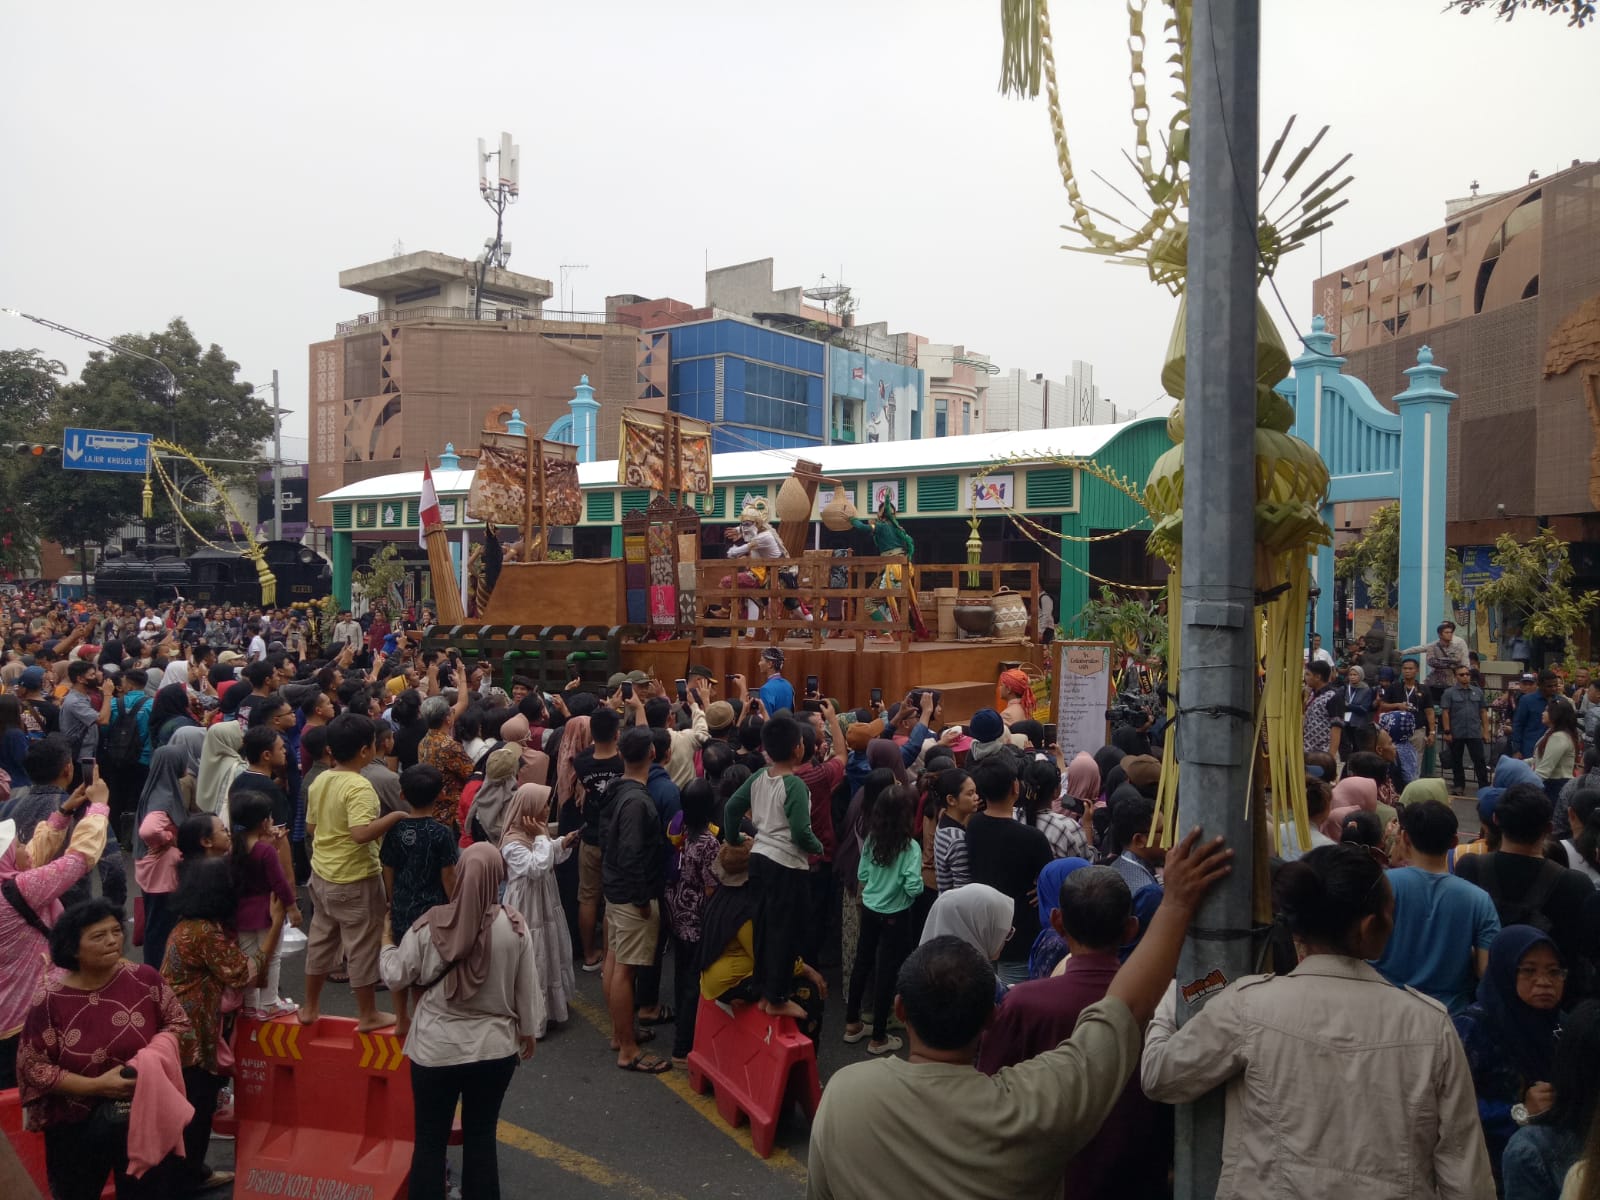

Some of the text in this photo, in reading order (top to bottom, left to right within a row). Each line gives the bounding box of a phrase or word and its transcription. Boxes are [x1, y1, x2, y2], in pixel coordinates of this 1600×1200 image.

[84, 455, 105, 464] LAJUR
[107, 456, 132, 465] KHUSUS
[285, 1175, 313, 1198] KOTA
[313, 1179, 375, 1200] SURAKARTA
